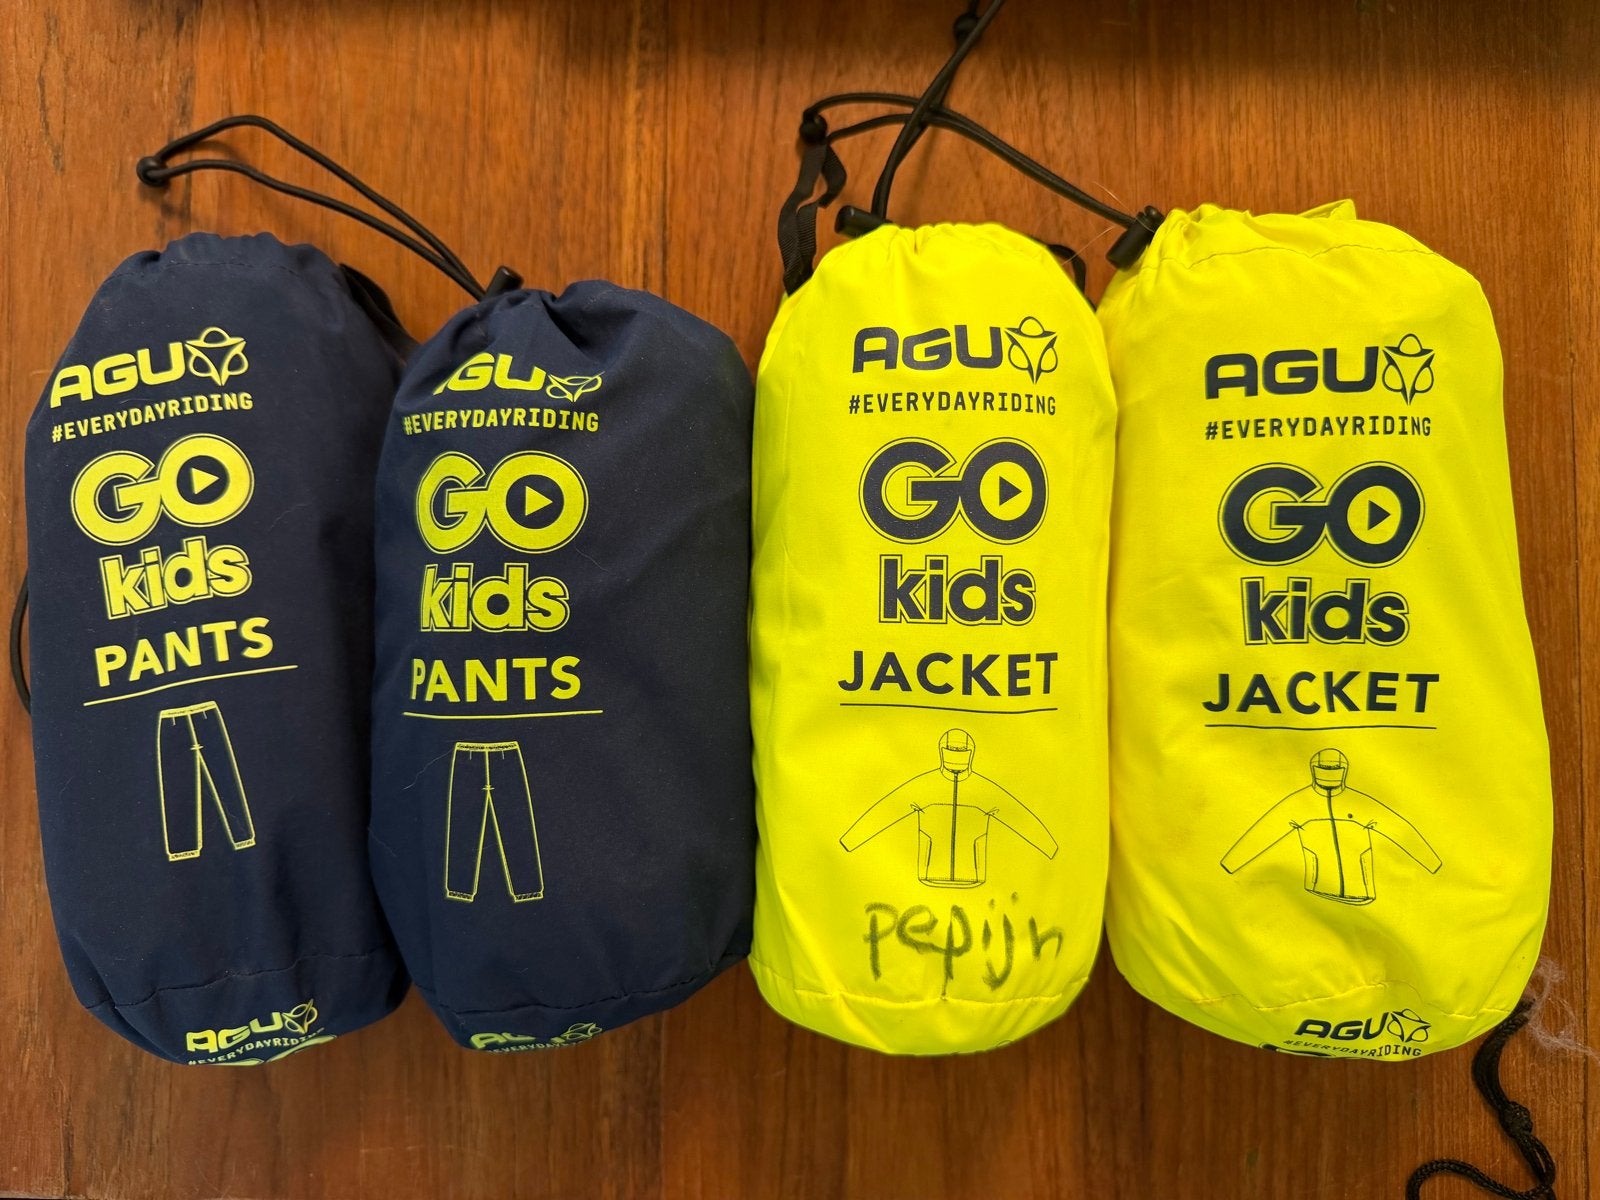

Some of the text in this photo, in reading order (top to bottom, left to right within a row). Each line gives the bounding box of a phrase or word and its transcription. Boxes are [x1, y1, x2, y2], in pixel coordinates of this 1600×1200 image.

[433, 352, 547, 396] GU
[852, 324, 1004, 373] AGU
[1205, 346, 1379, 400] AGU
[50, 342, 186, 408] AGU
[51, 392, 253, 443] #EVERYDAYRIDING
[404, 407, 599, 435] #EVERYDAYRIDING
[849, 391, 1056, 416] #EVERYDAYRIDING
[1205, 415, 1431, 440] #EVERYDAYRIDING
[71, 433, 255, 546] GO
[416, 450, 589, 555] GO
[858, 436, 1049, 545] GO
[1217, 460, 1425, 569] GO
[99, 535, 253, 620] kids
[420, 562, 570, 632] kids
[879, 554, 1036, 627] kids
[1240, 576, 1410, 647] kids
[94, 616, 274, 688] PANTS
[838, 650, 1058, 697] JACKET
[410, 655, 581, 702] PANTS
[1202, 670, 1440, 715] JACKET
[186, 1012, 284, 1054] AGU
[1294, 1011, 1390, 1041] AGU
